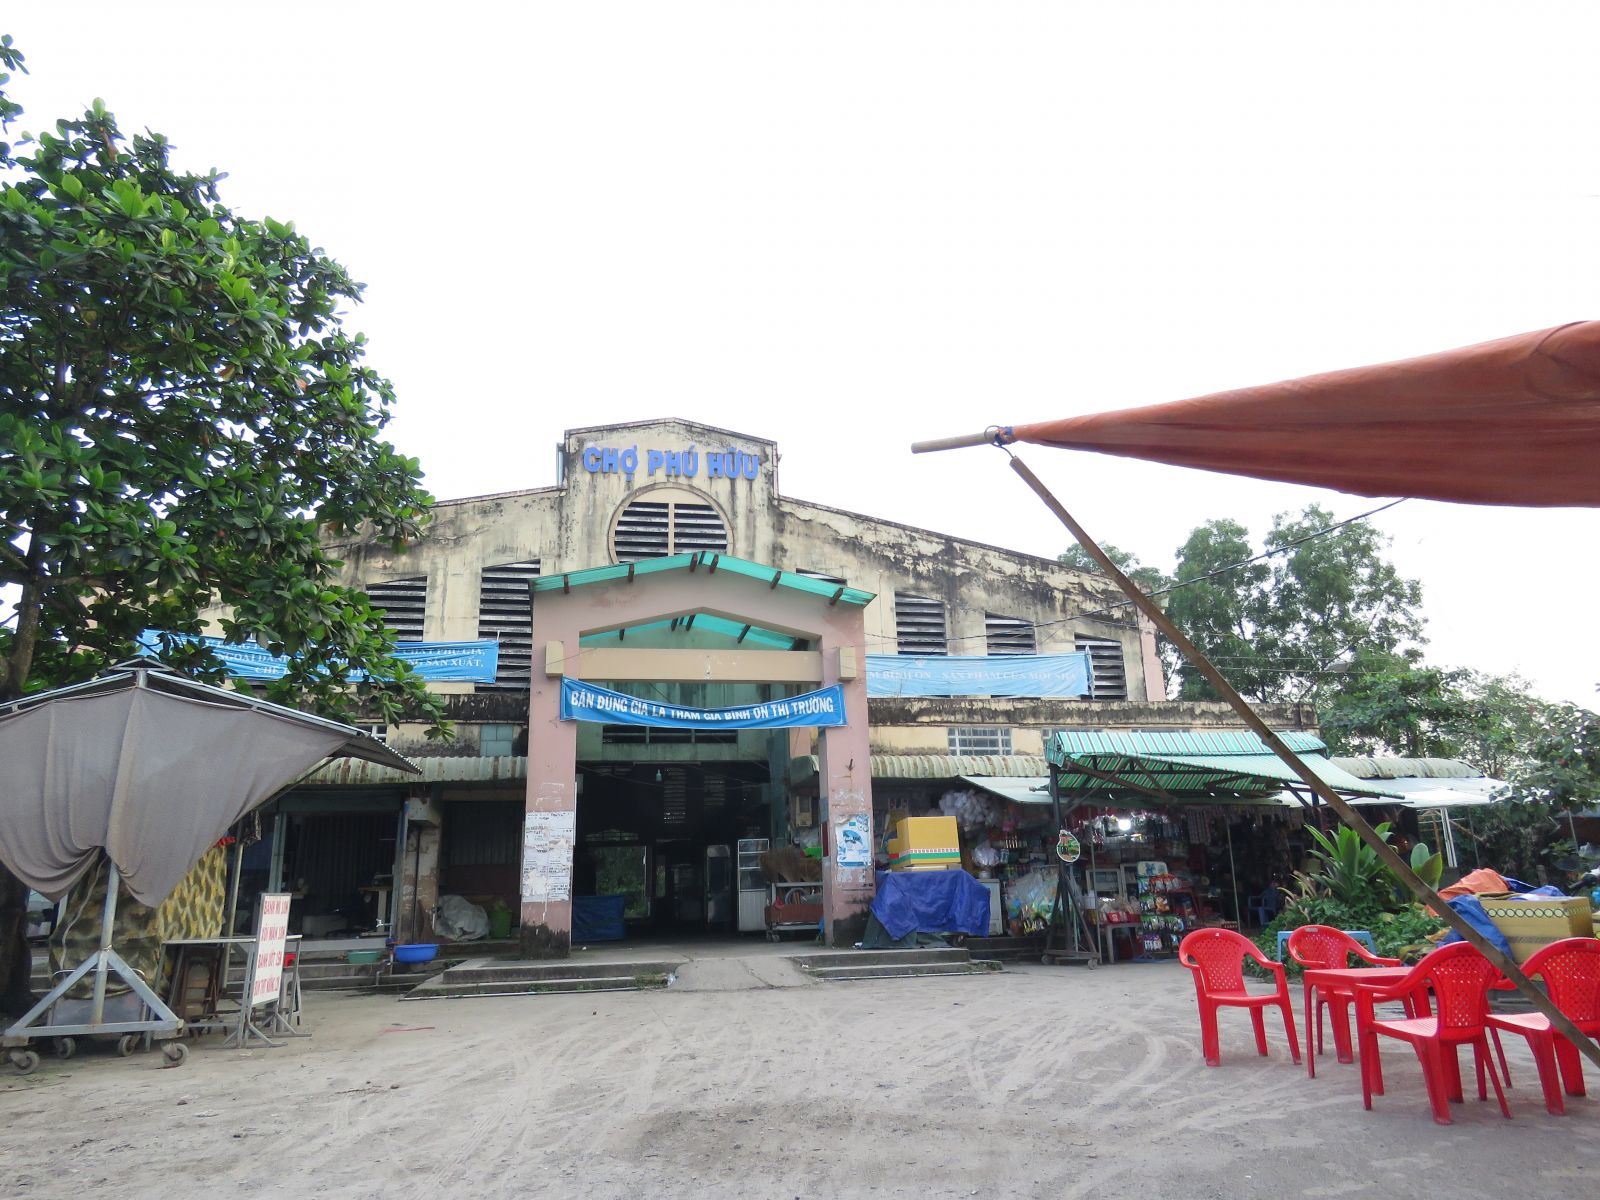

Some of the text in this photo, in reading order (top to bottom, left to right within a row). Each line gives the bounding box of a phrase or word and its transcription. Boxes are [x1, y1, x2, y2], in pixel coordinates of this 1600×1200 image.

[583, 442, 760, 482] CHỢ PHÚ HỮU
[671, 709, 701, 721] THAM
[791, 696, 834, 715] TRƯỜNG
